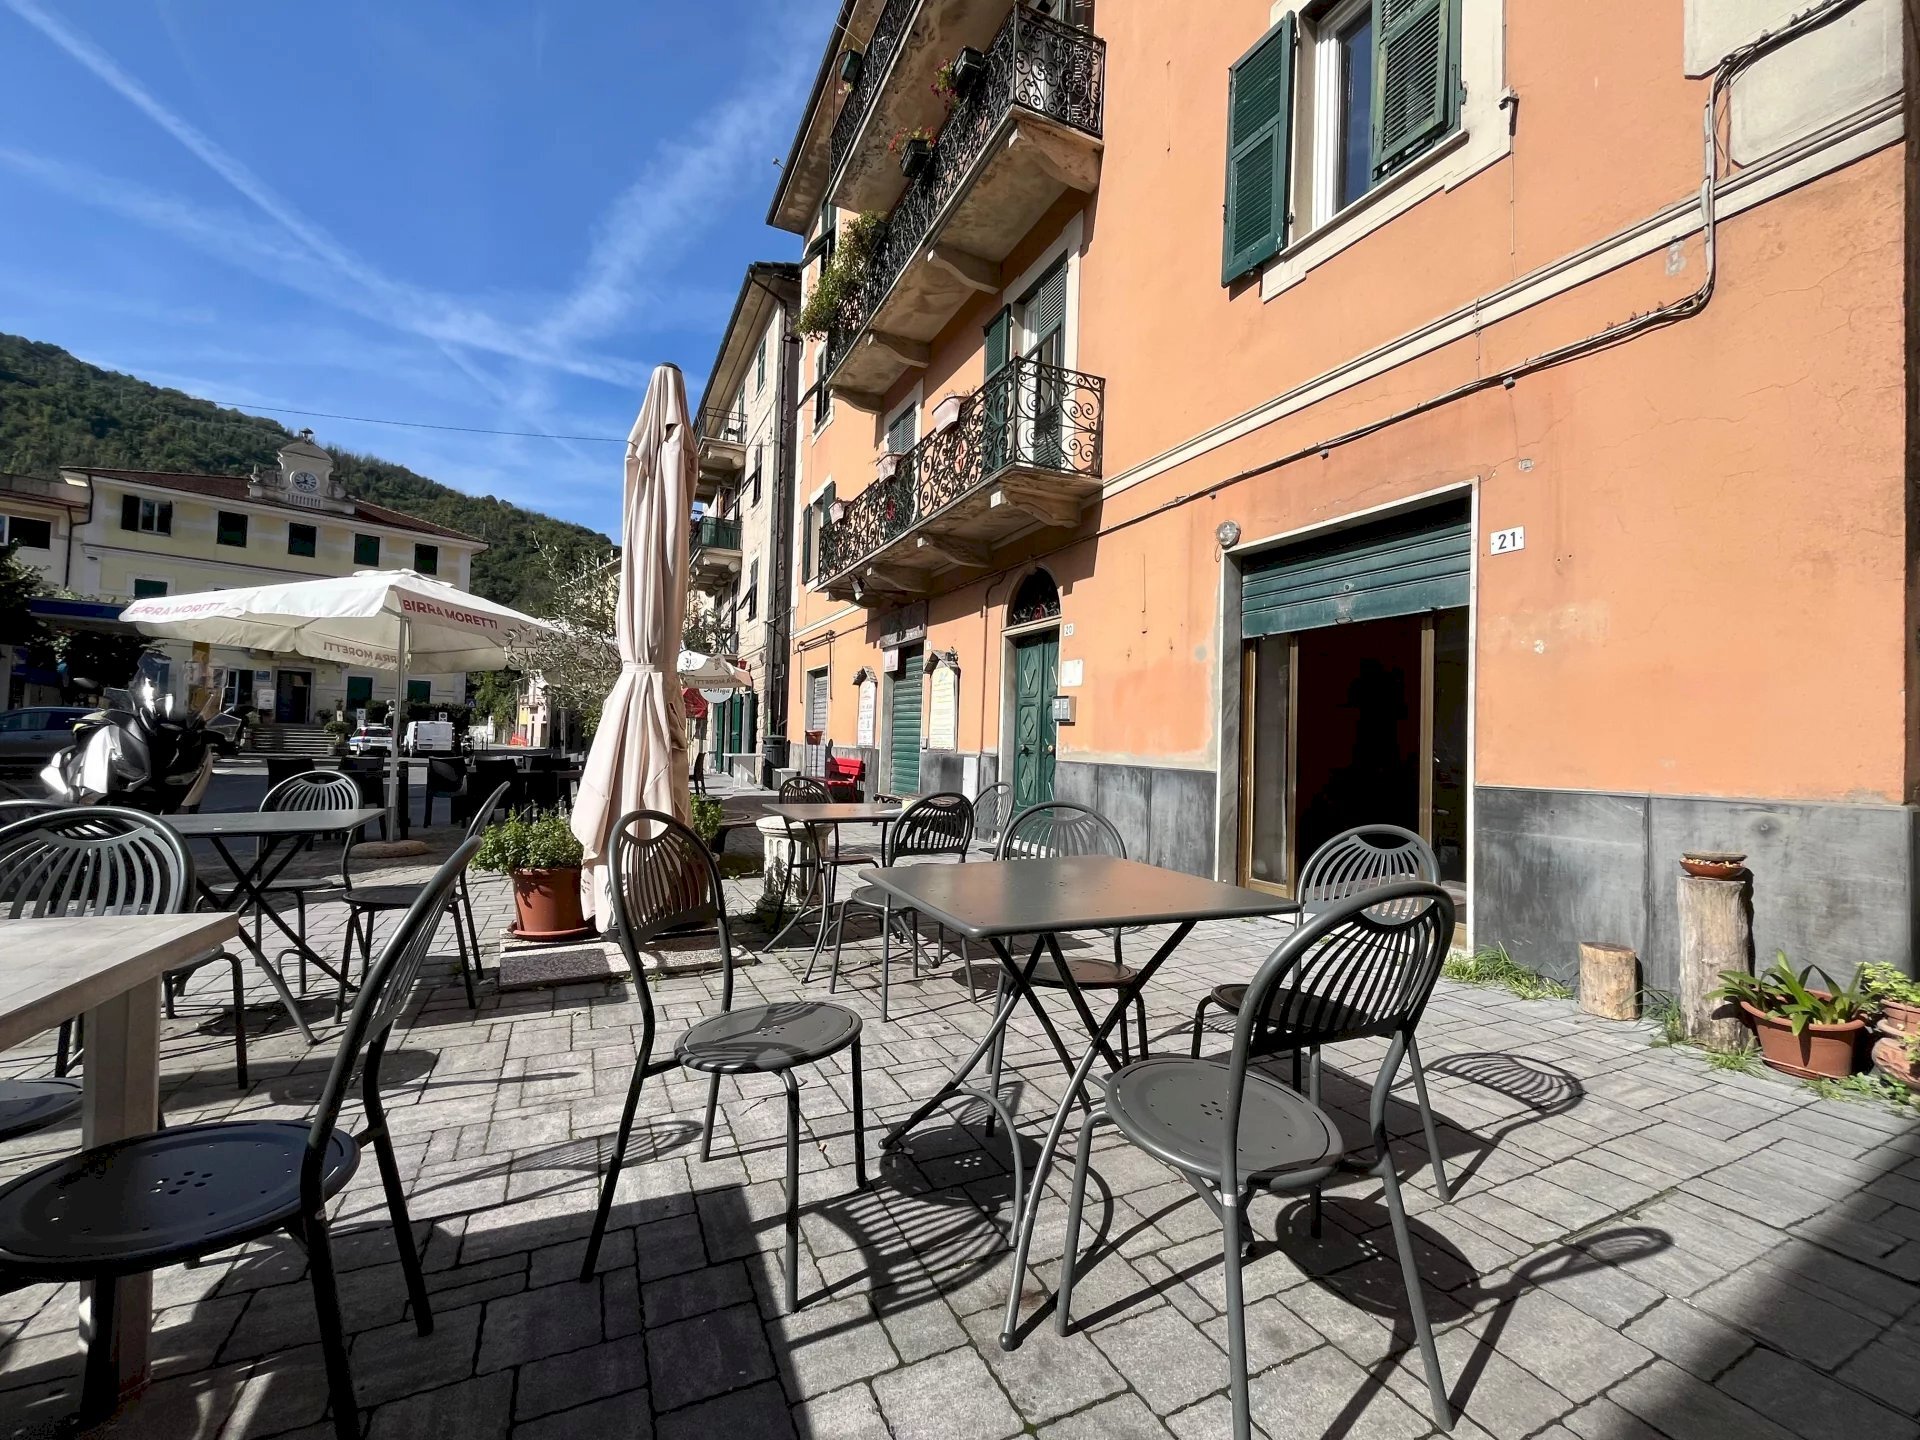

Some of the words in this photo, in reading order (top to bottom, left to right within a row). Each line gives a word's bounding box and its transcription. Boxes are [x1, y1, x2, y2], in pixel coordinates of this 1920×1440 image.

[1498, 531, 1516, 550] 21
[403, 600, 444, 616] BIRRA
[445, 609, 498, 630] MORETTI
[1065, 625, 1073, 635] 20
